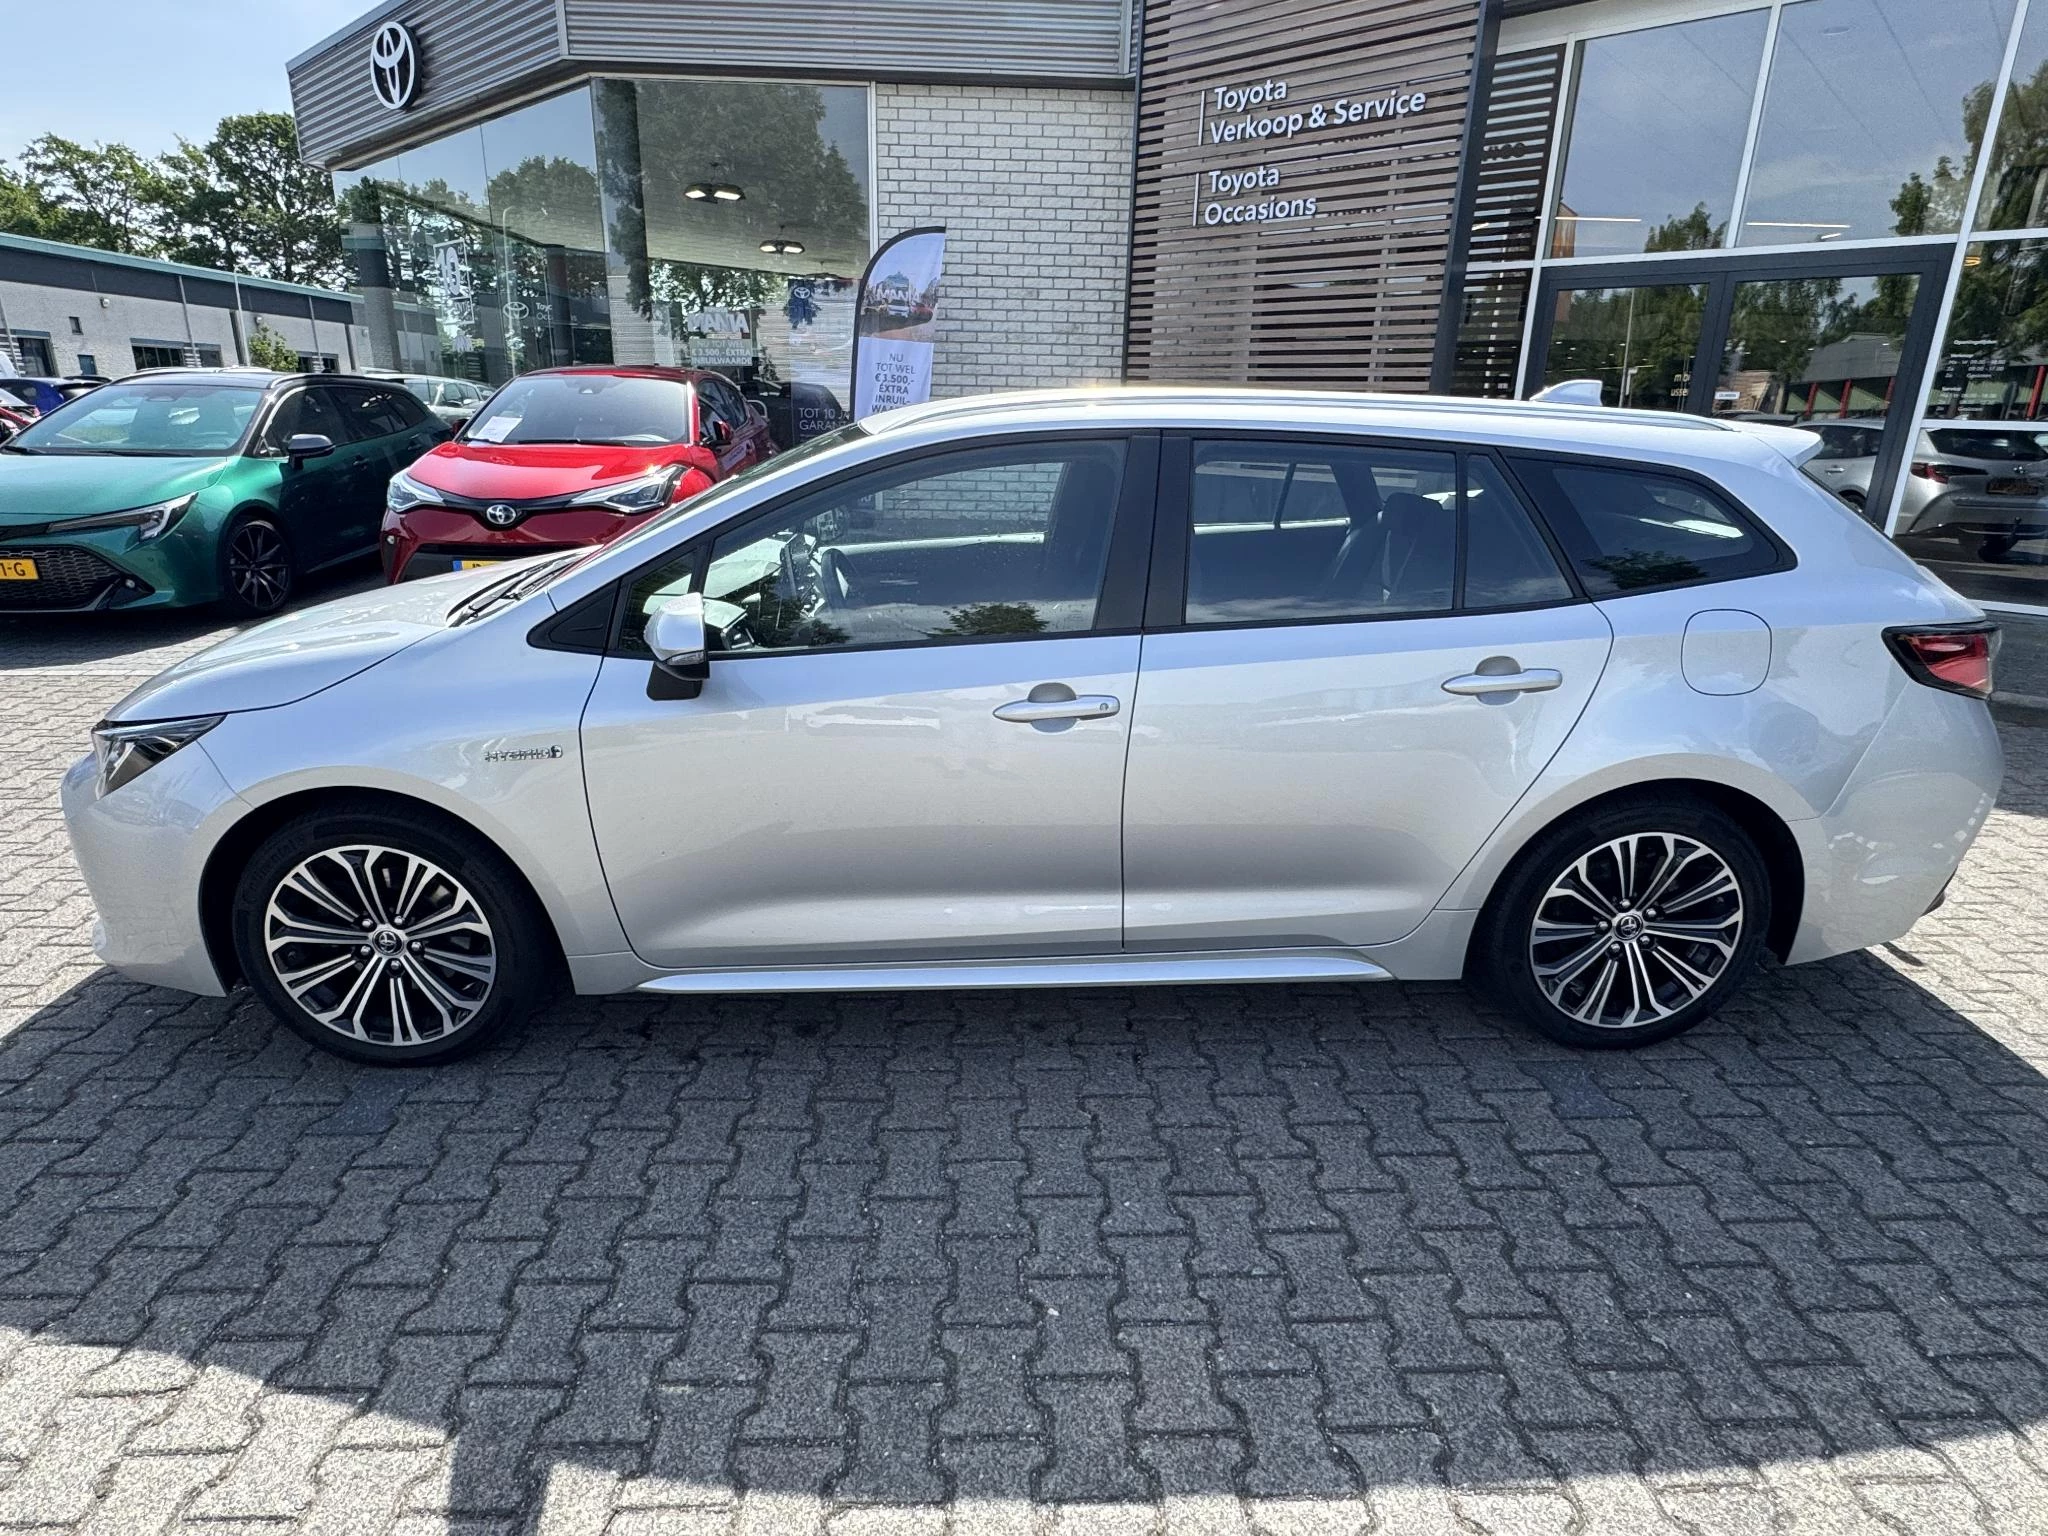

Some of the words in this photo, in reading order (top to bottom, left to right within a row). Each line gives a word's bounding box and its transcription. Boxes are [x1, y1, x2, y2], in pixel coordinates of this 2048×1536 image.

[1214, 79, 1288, 112] Toyota
[1210, 113, 1304, 144] Verkoop
[1308, 103, 1328, 129] &
[1333, 89, 1427, 125] Service
[1208, 165, 1281, 197] Toyota
[1204, 196, 1318, 225] Occasions
[889, 353, 904, 362] NU
[876, 362, 892, 372] TOT
[895, 363, 916, 374] WEL
[875, 394, 911, 404] INRUIL-
[798, 407, 820, 418] TOT
[823, 408, 836, 419] 10
